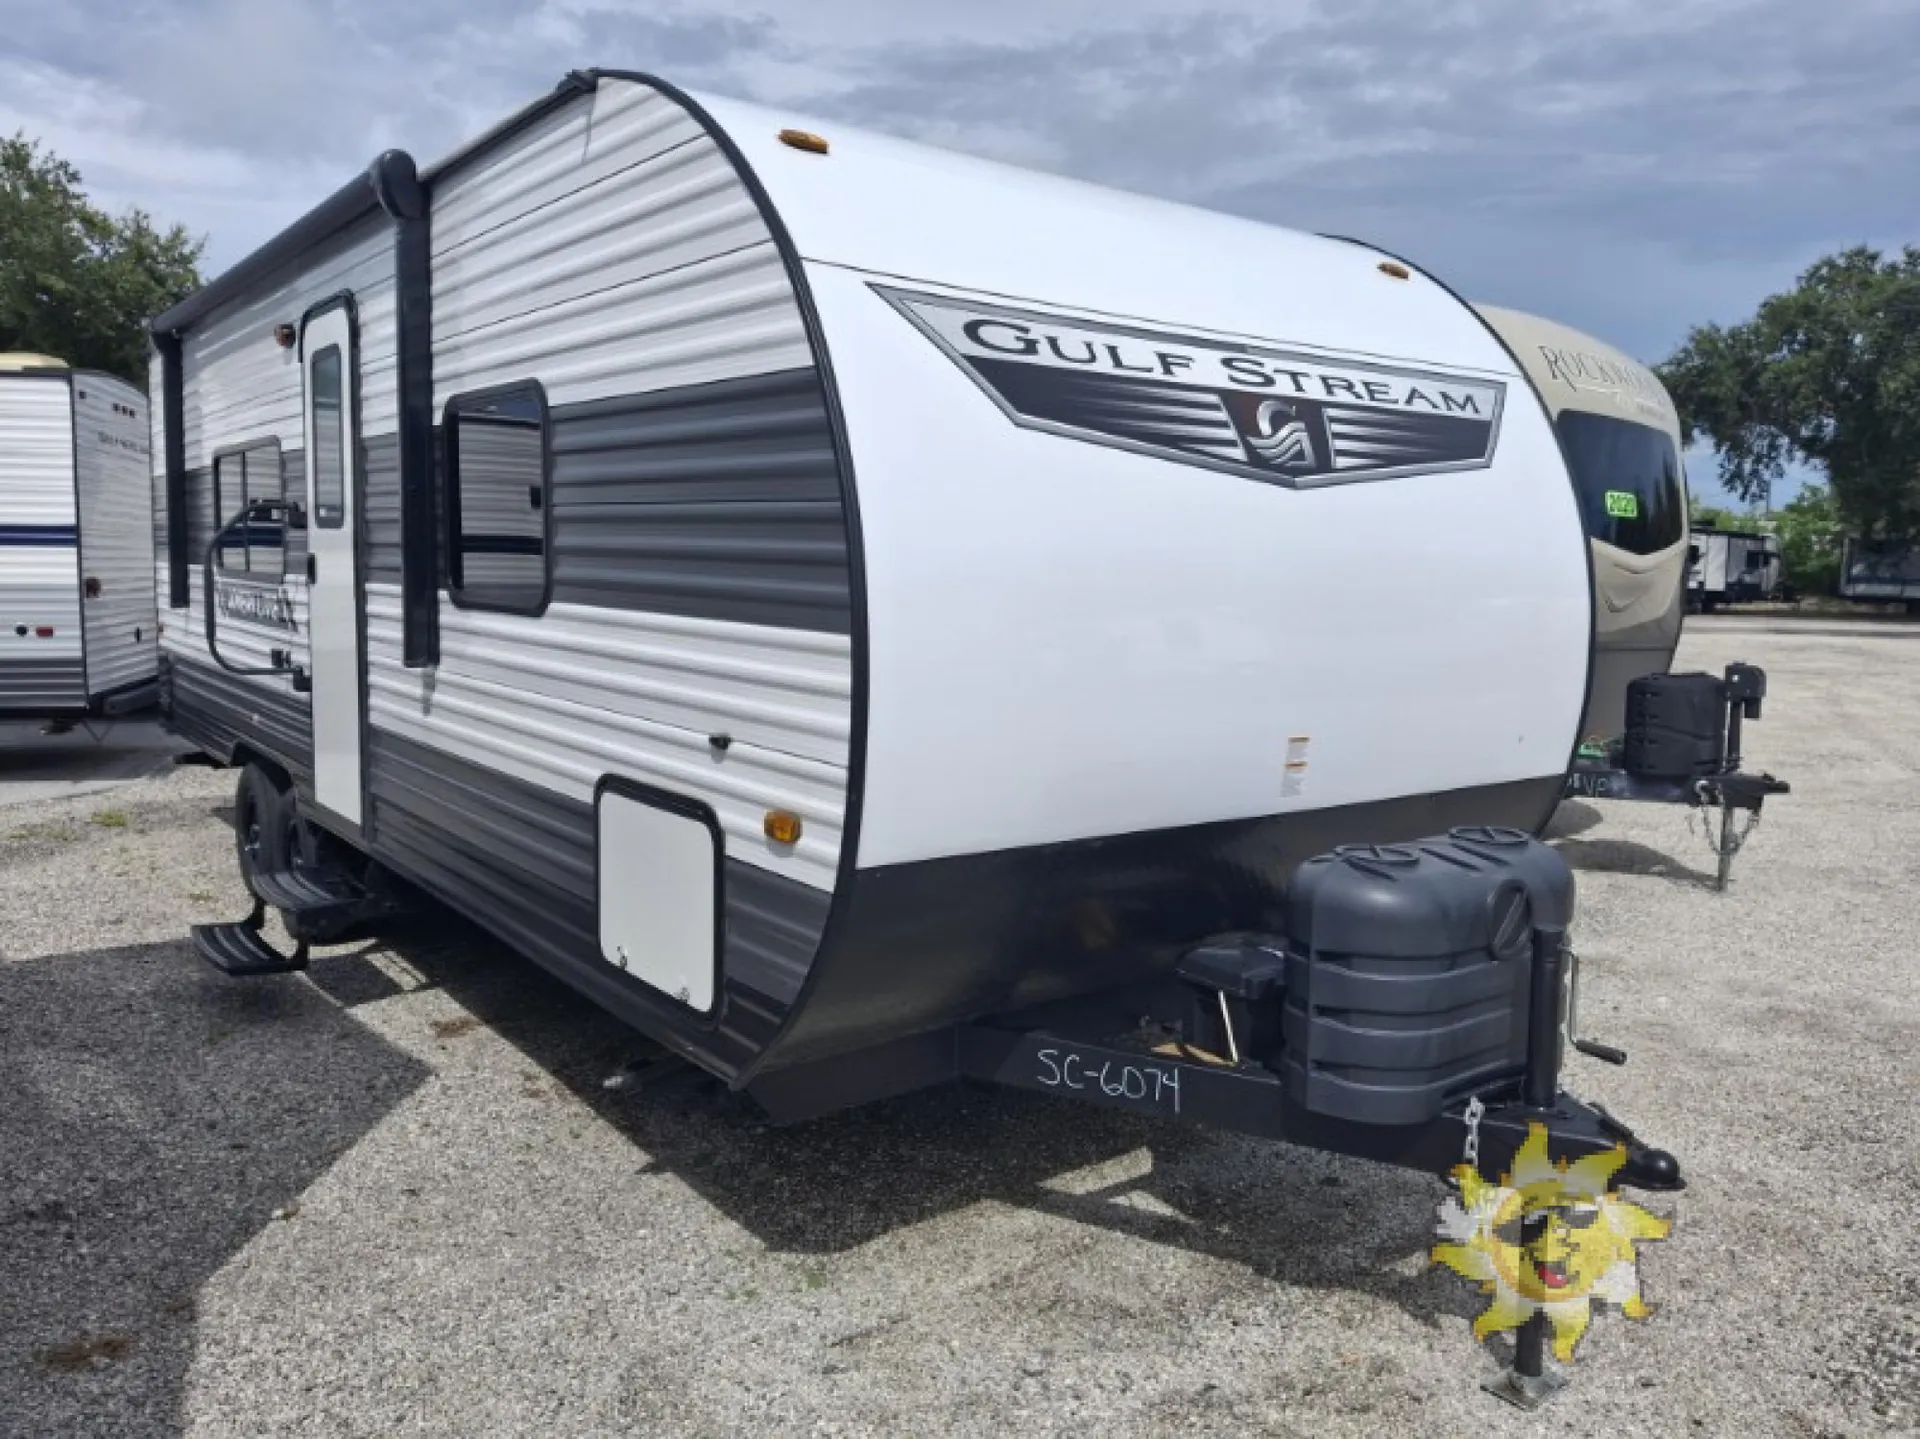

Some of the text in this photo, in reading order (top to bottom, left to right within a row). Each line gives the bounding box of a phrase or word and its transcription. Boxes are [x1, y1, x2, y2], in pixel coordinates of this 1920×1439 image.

[962, 318, 1481, 414] GULF STREAM
[1037, 1049, 1180, 1113] SC-6074
